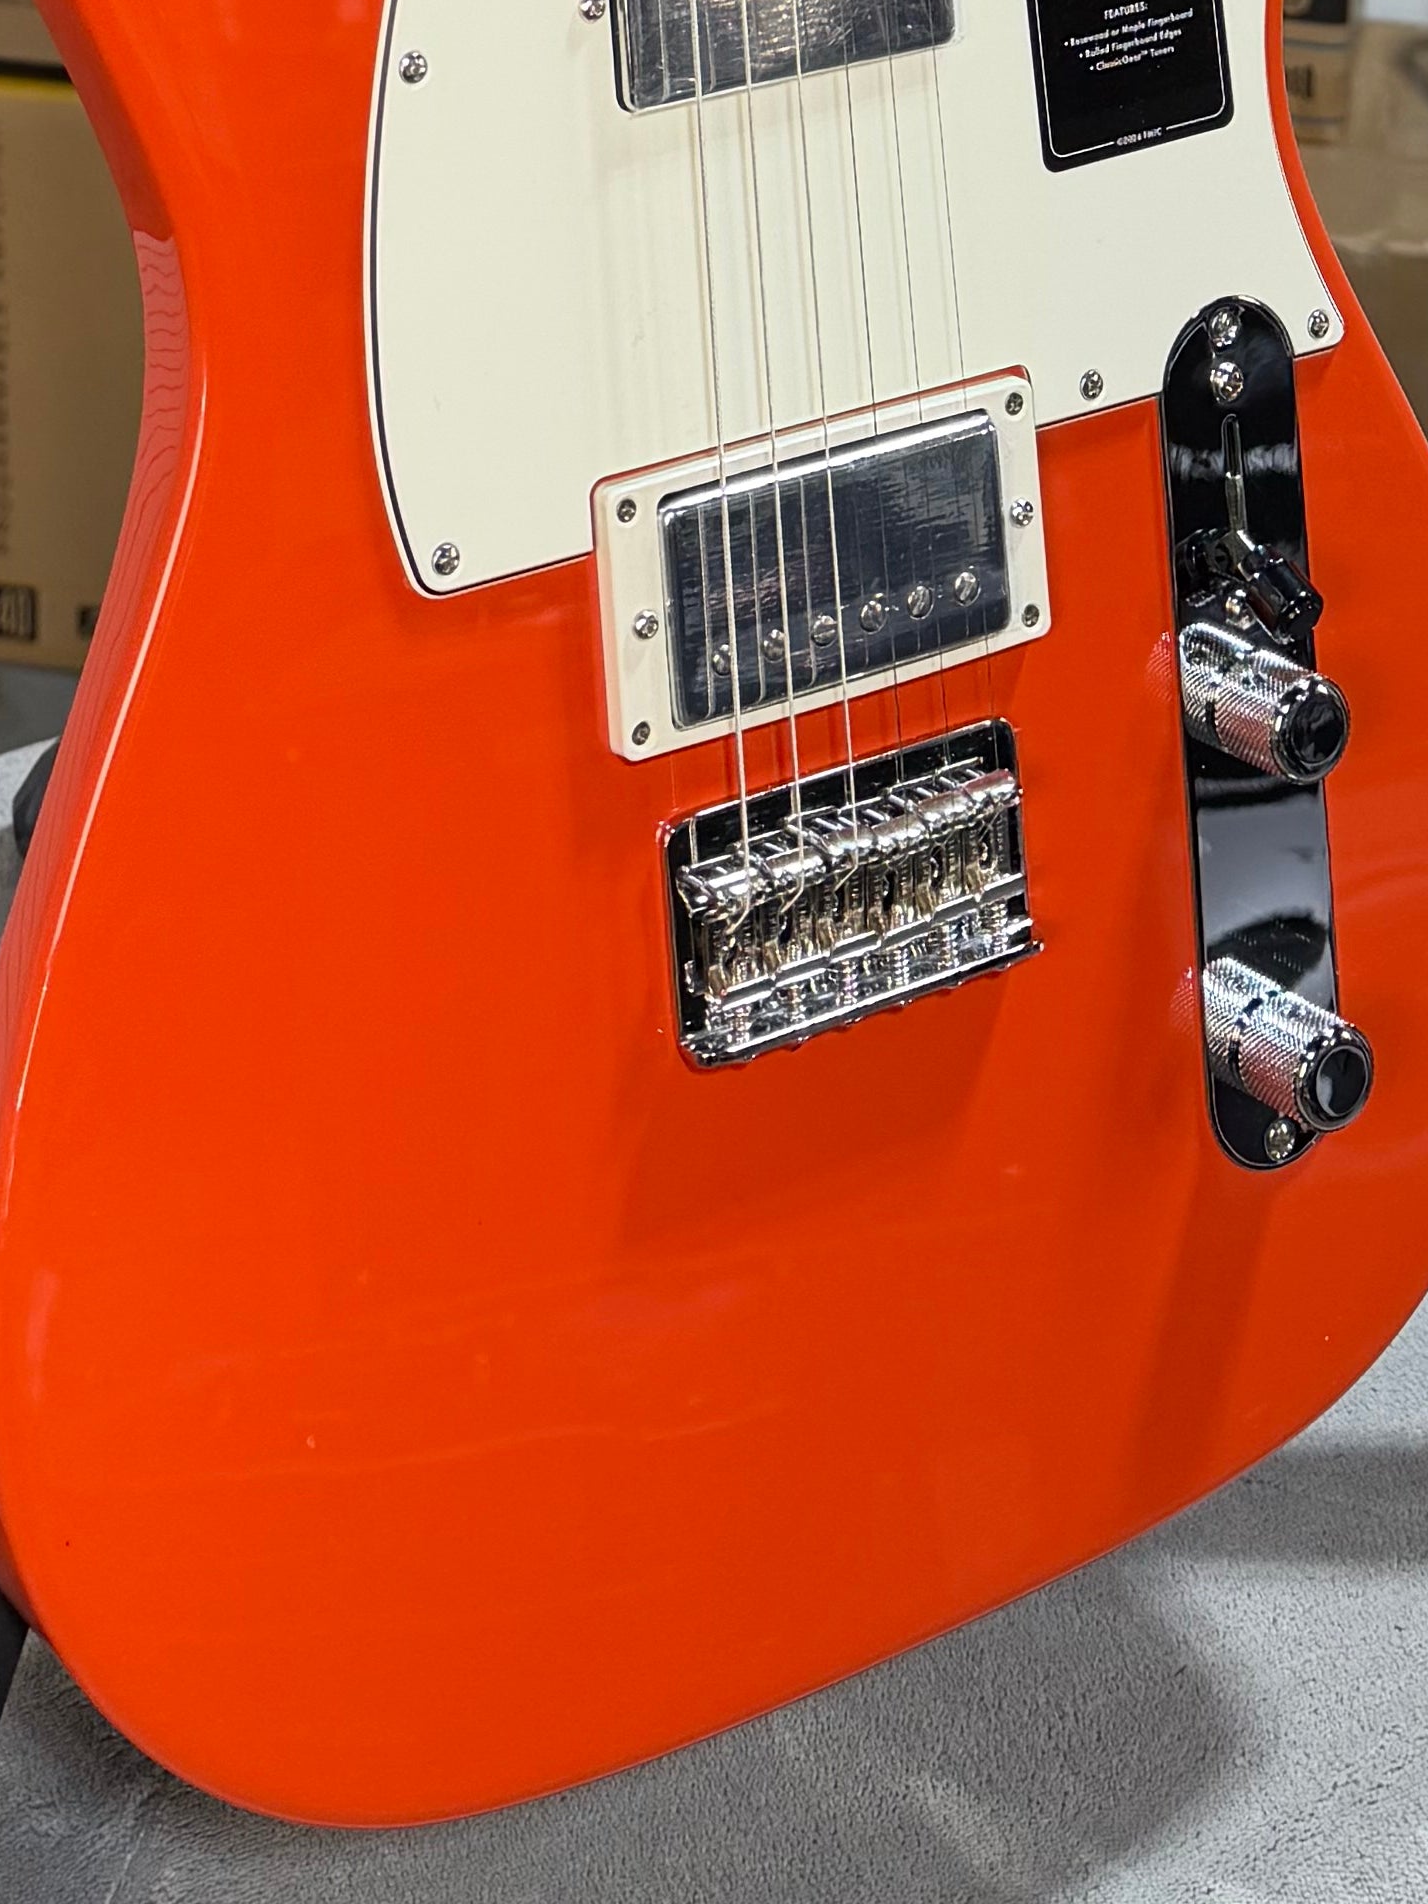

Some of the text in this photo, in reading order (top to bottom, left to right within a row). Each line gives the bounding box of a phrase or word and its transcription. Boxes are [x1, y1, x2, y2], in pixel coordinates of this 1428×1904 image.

[1103, 0, 1149, 20] FEATURES:
[1070, 7, 1194, 47] Rosewood or Maple Fingerboard
[1085, 28, 1182, 59] Rolled Fingerboard Edges
[1150, 45, 1175, 58] Tuners
